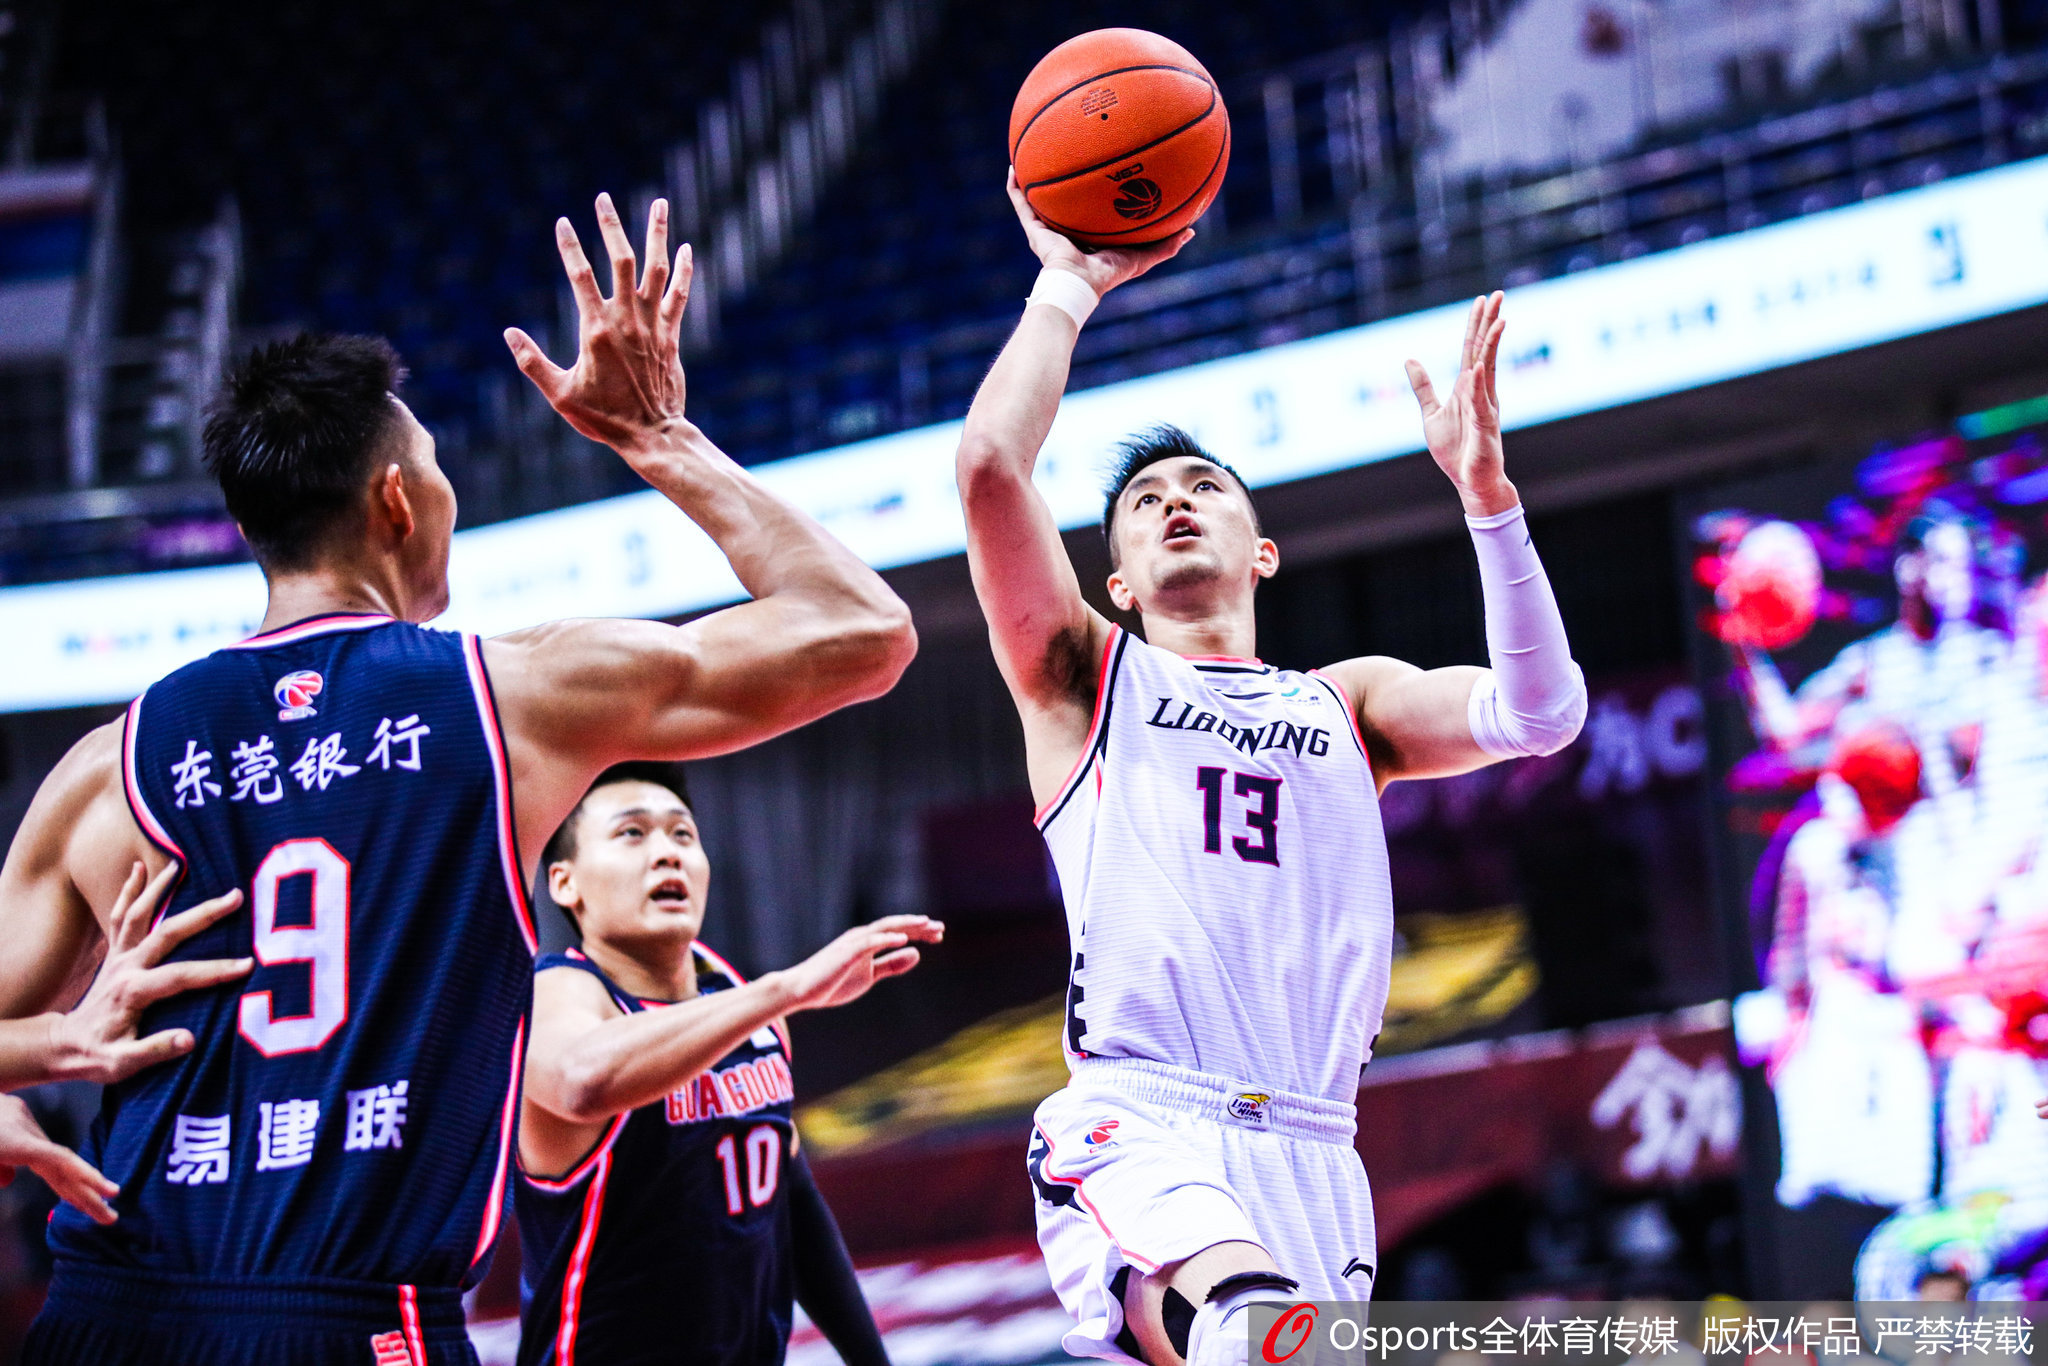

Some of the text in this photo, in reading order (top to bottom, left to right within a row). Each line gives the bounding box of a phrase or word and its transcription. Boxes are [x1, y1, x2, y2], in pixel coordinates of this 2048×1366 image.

[171, 714, 430, 808] 东莞银行
[1146, 697, 1331, 758] LIAONING
[1196, 765, 1283, 868] 13
[238, 837, 350, 1058] 9
[166, 1080, 409, 1186] 易建联
[716, 1122, 780, 1217] 10
